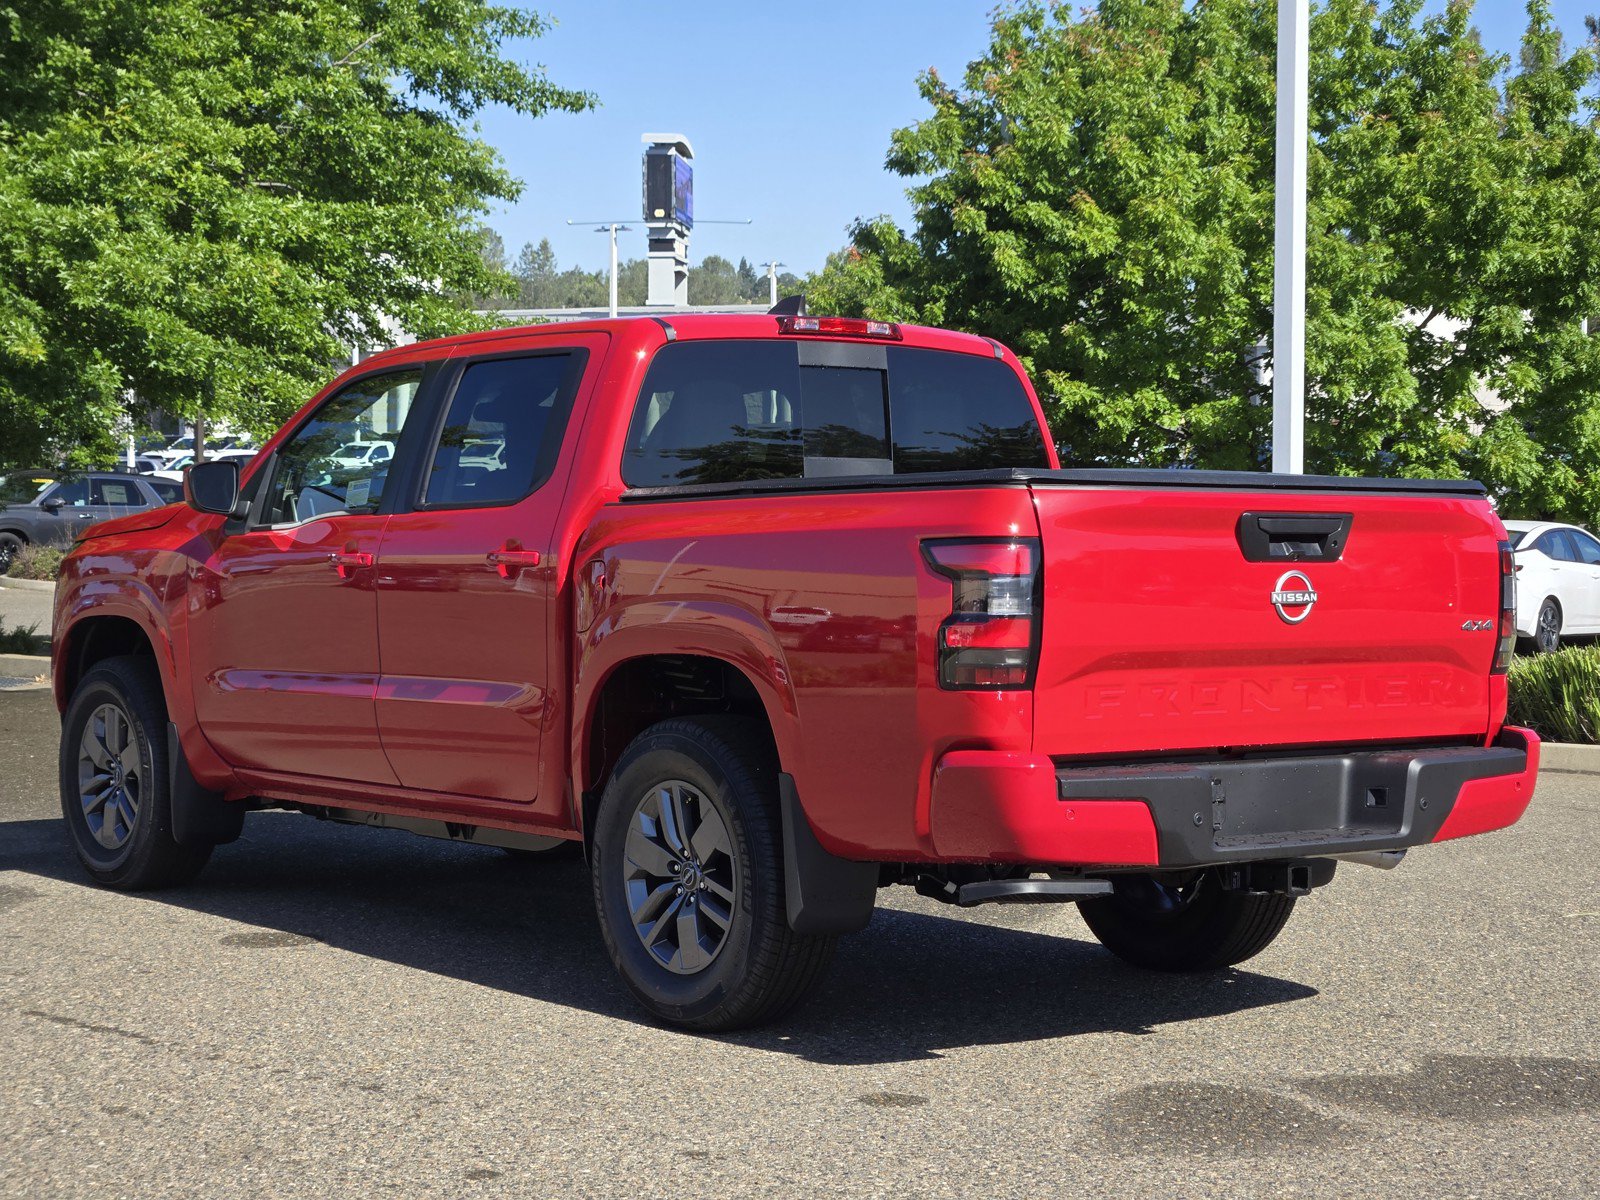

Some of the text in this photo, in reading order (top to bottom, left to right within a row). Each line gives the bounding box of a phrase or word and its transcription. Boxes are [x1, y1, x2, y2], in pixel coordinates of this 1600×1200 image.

[1272, 592, 1318, 602] NISSAN
[1084, 674, 1455, 719] FRONTIER
[733, 819, 753, 911] MICHELIN
